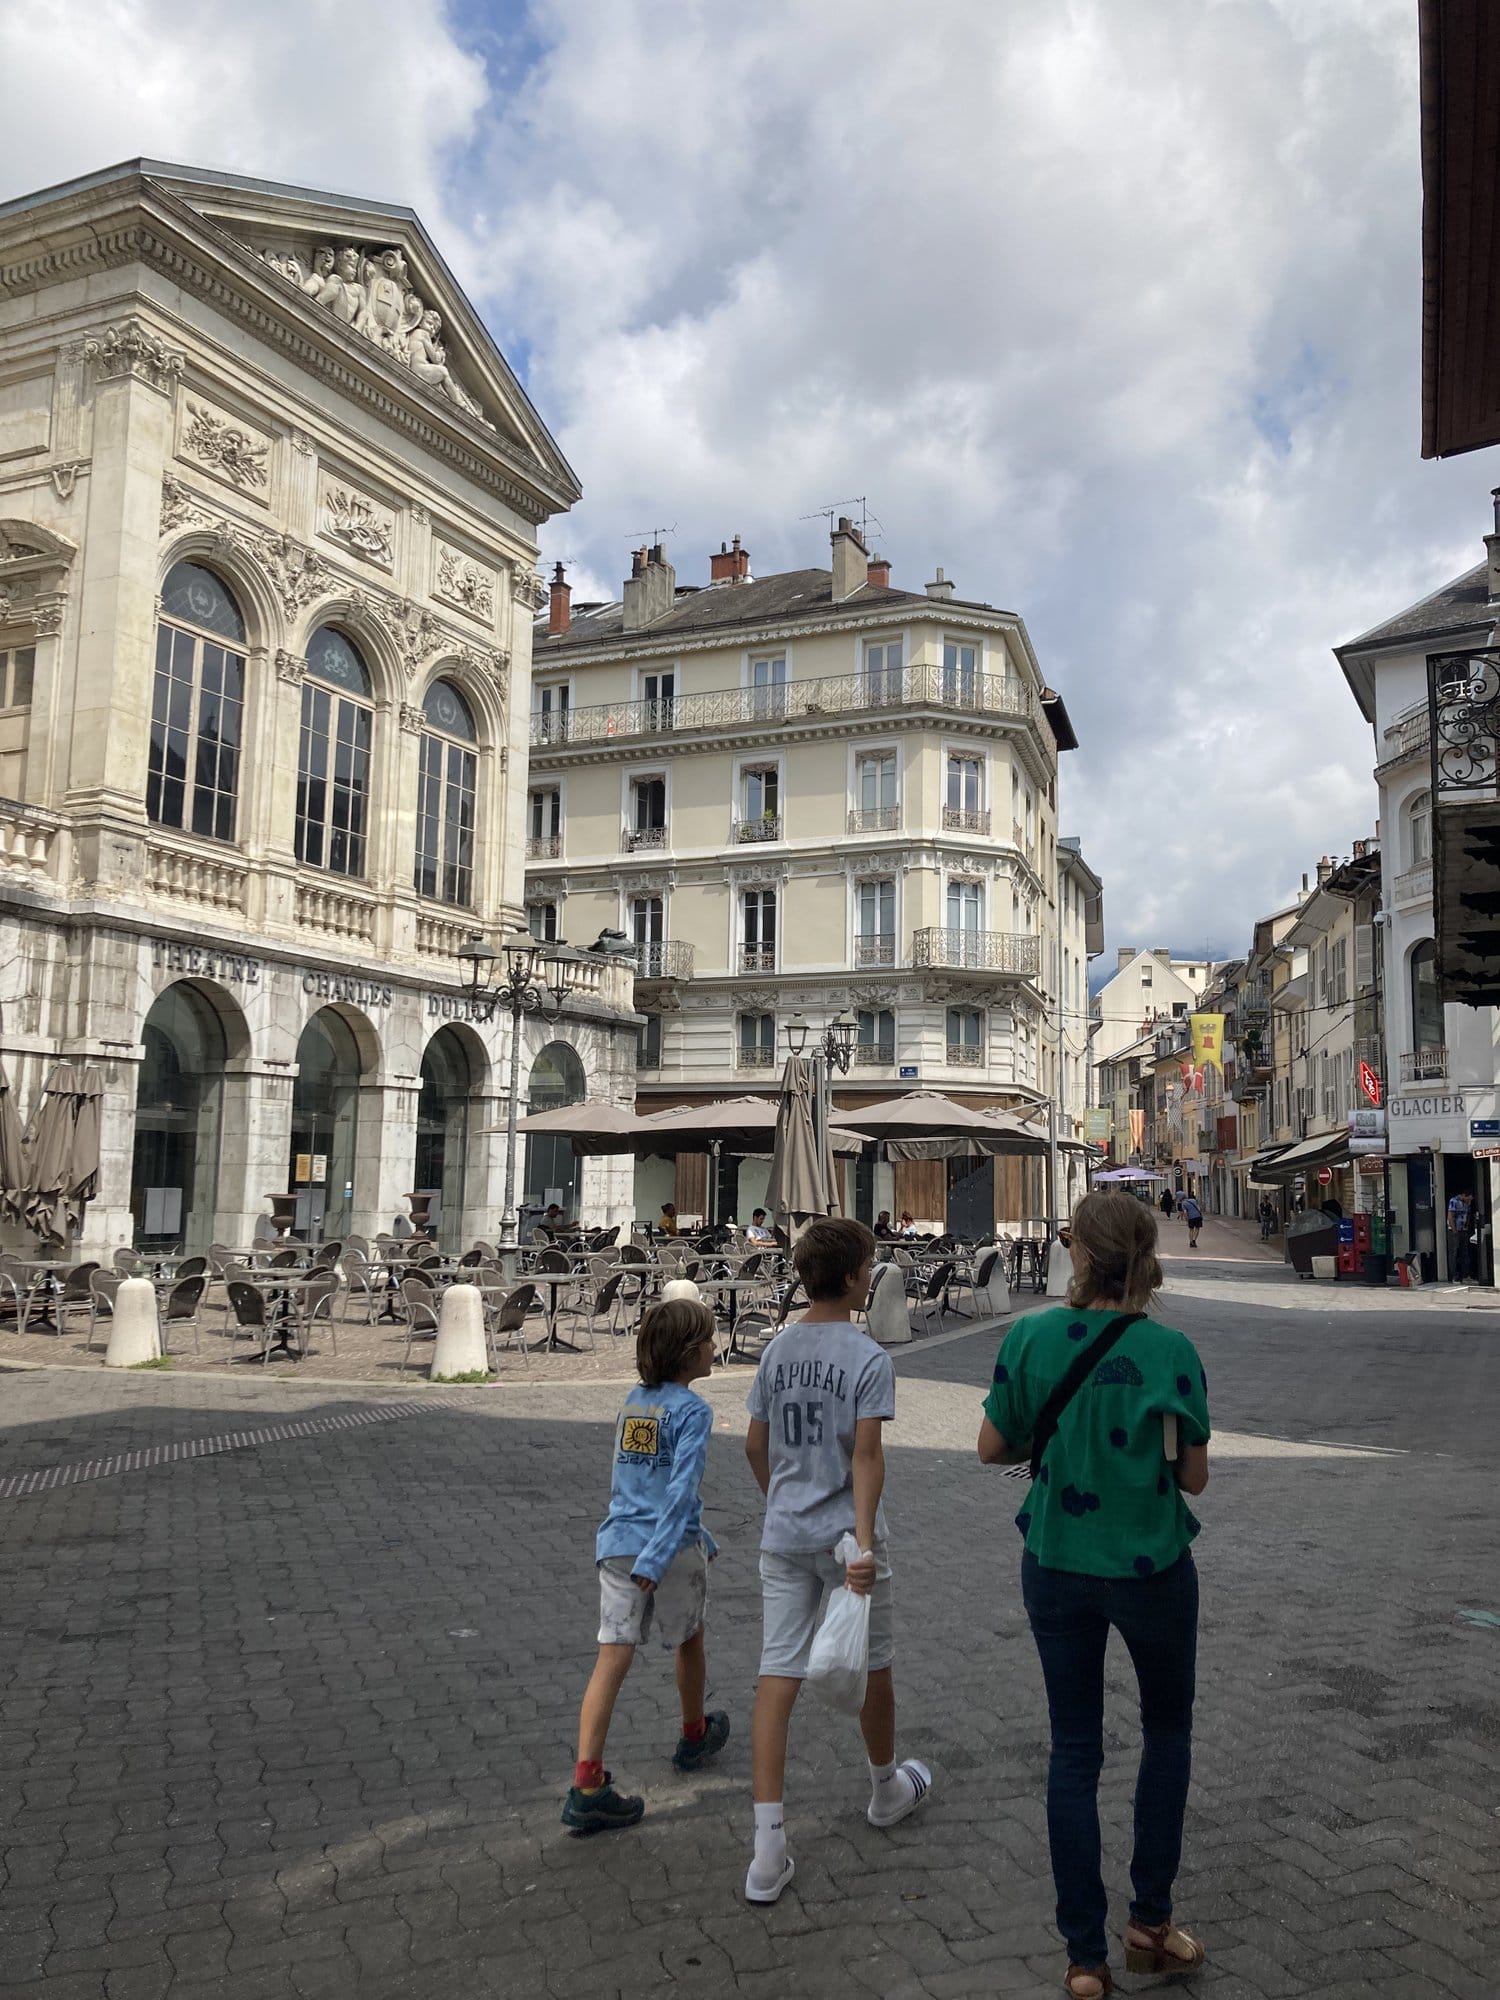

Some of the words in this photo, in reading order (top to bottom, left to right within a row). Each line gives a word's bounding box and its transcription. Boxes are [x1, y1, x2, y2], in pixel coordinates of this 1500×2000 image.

[302, 972, 393, 1009] CHARLES
[427, 995, 496, 1024] DULLIN
[1391, 1096, 1465, 1117] GLACIER
[770, 1360, 847, 1402] APORAL
[782, 1402, 824, 1448] 05
